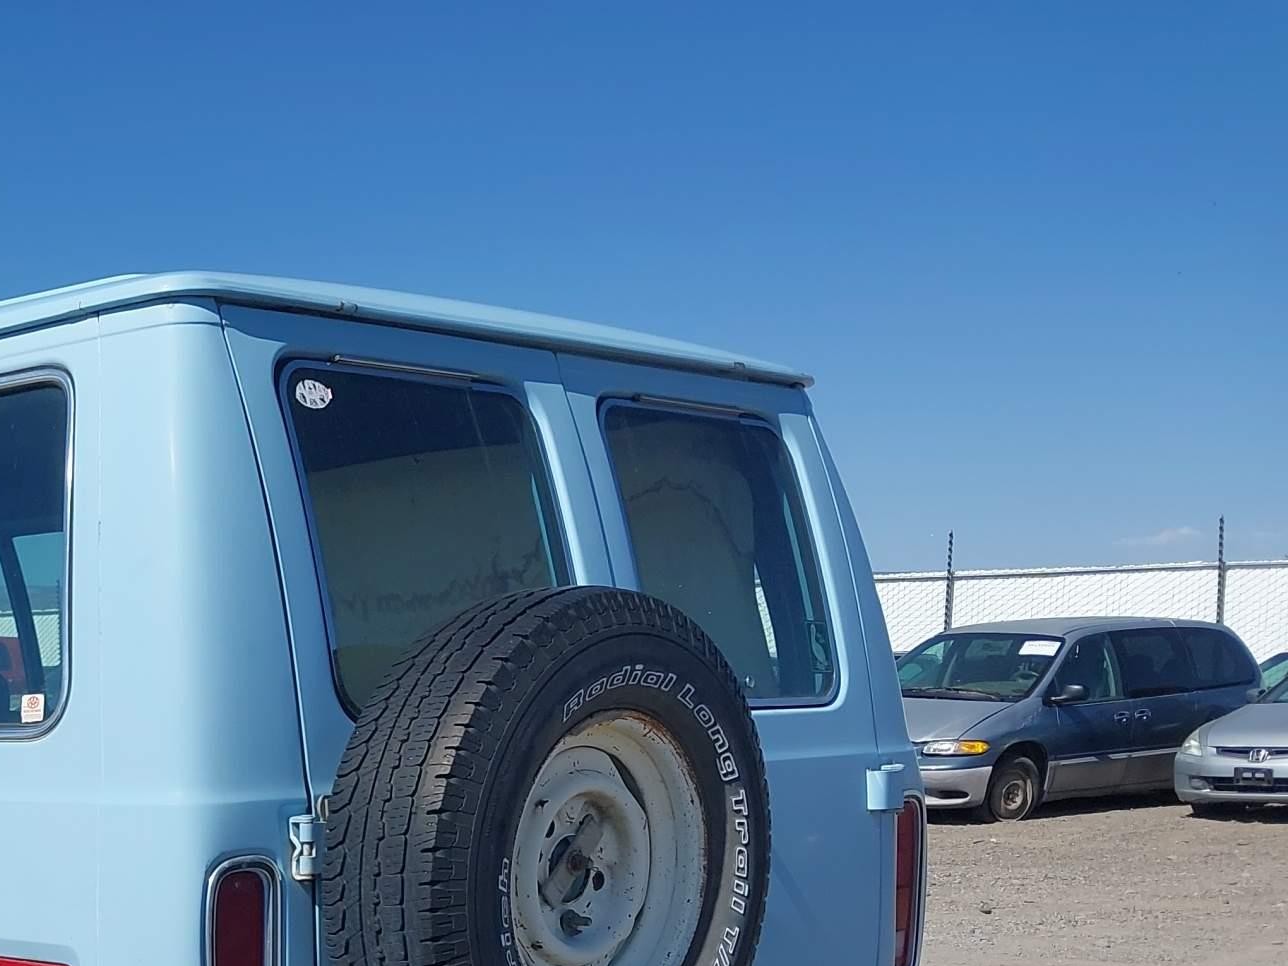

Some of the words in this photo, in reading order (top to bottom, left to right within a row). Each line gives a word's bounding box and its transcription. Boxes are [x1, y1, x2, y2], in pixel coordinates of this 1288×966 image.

[562, 664, 677, 722] Radial
[676, 683, 740, 782] Long
[730, 789, 750, 915] Trail
